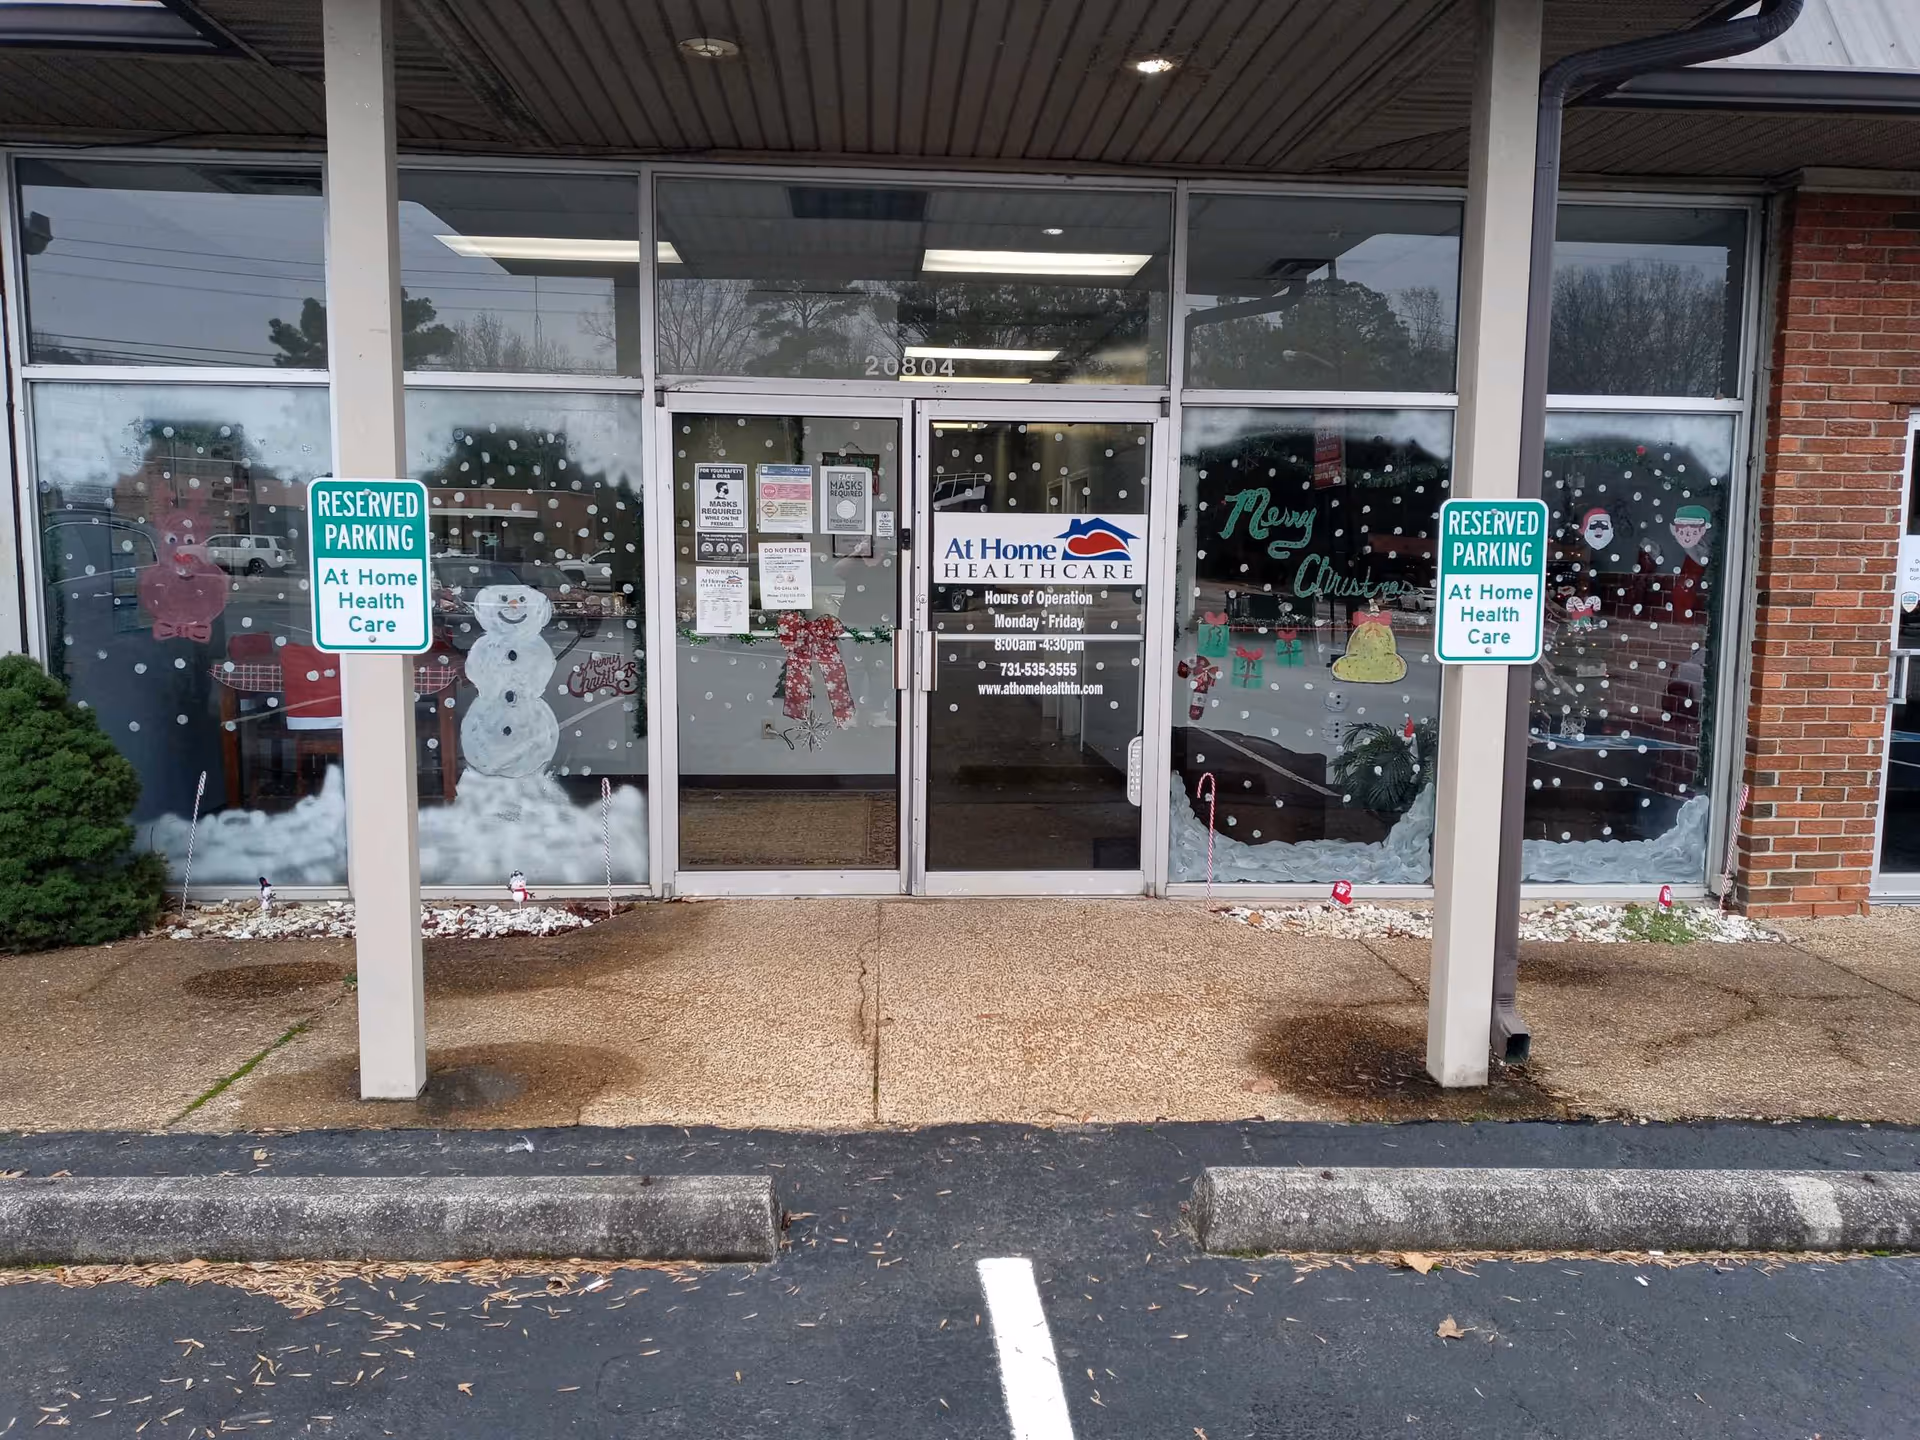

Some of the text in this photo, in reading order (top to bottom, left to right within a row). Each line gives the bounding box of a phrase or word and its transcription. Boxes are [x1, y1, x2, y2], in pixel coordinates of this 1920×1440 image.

[864, 355, 955, 377] 20804
[838, 473, 855, 481] FACE
[830, 481, 863, 490] MASKS
[830, 490, 863, 498] REQUIRED
[317, 490, 419, 518] RESERVED
[1218, 487, 1317, 559] Merry
[1449, 510, 1539, 536] RESERVED
[325, 523, 414, 551] PARKING
[944, 537, 1057, 560] At Home
[1452, 541, 1532, 567] PARKING
[323, 568, 418, 586] At Home
[944, 563, 1133, 579] HEALTHCARE
[984, 590, 1093, 606] Hours of Operation
[1448, 584, 1534, 600] At Home
[338, 592, 405, 609] Health
[1460, 606, 1519, 622] Health
[349, 616, 396, 633] Care
[994, 614, 1040, 631] Monday
[1048, 614, 1084, 631] Friday
[1468, 628, 1511, 644] Care
[994, 637, 1036, 652] 8:00am
[1000, 662, 1077, 676] 731-535-3555
[978, 682, 1103, 696] www.athomehealthtn.com
